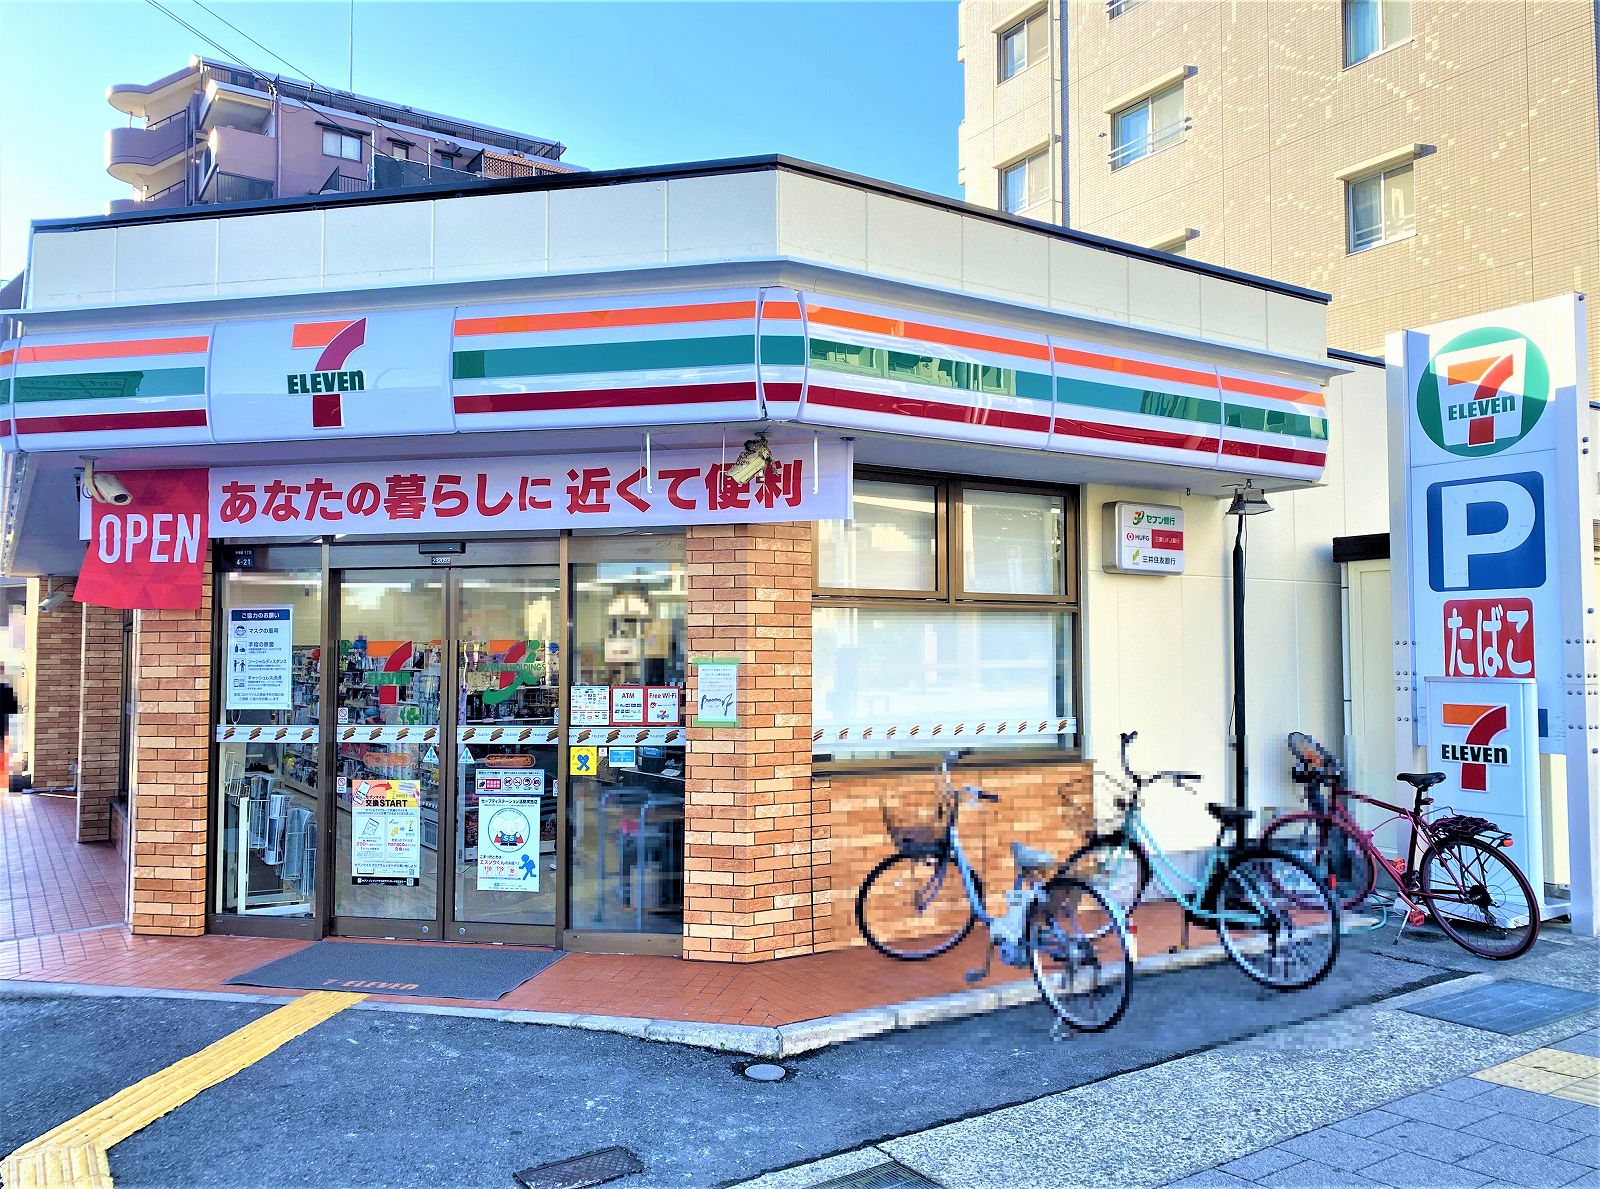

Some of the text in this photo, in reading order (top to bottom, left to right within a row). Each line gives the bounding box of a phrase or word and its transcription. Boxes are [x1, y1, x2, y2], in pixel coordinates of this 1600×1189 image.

[292, 318, 367, 428] 7
[1447, 353, 1514, 446] 7
[220, 460, 803, 524] あなたの暮らしに 近くて便利
[1146, 514, 1175, 525] セブン銀行
[98, 513, 201, 564] OPEN
[1142, 555, 1176, 565] 三井住友銀行
[1441, 480, 1536, 588] P
[1447, 604, 1533, 677] たばこ
[1442, 702, 1508, 792] 7
